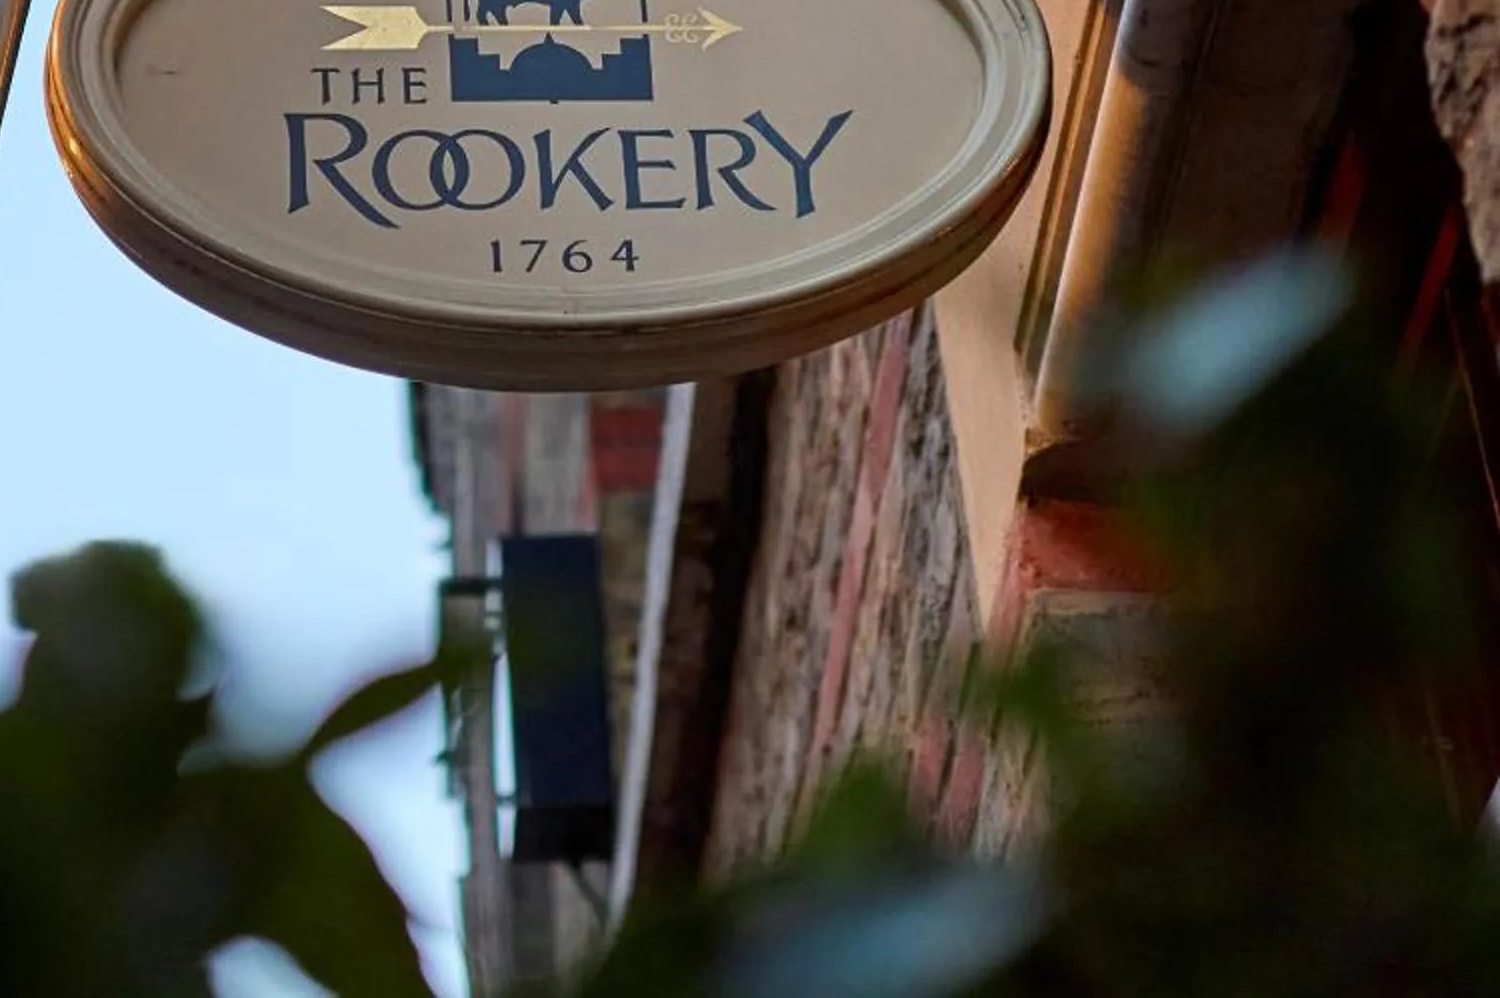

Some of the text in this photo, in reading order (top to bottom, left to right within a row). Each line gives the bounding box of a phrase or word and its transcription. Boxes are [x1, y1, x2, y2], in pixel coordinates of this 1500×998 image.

[310, 67, 428, 105] THE
[283, 109, 855, 229] ROOKERY
[490, 239, 640, 274] 1764
